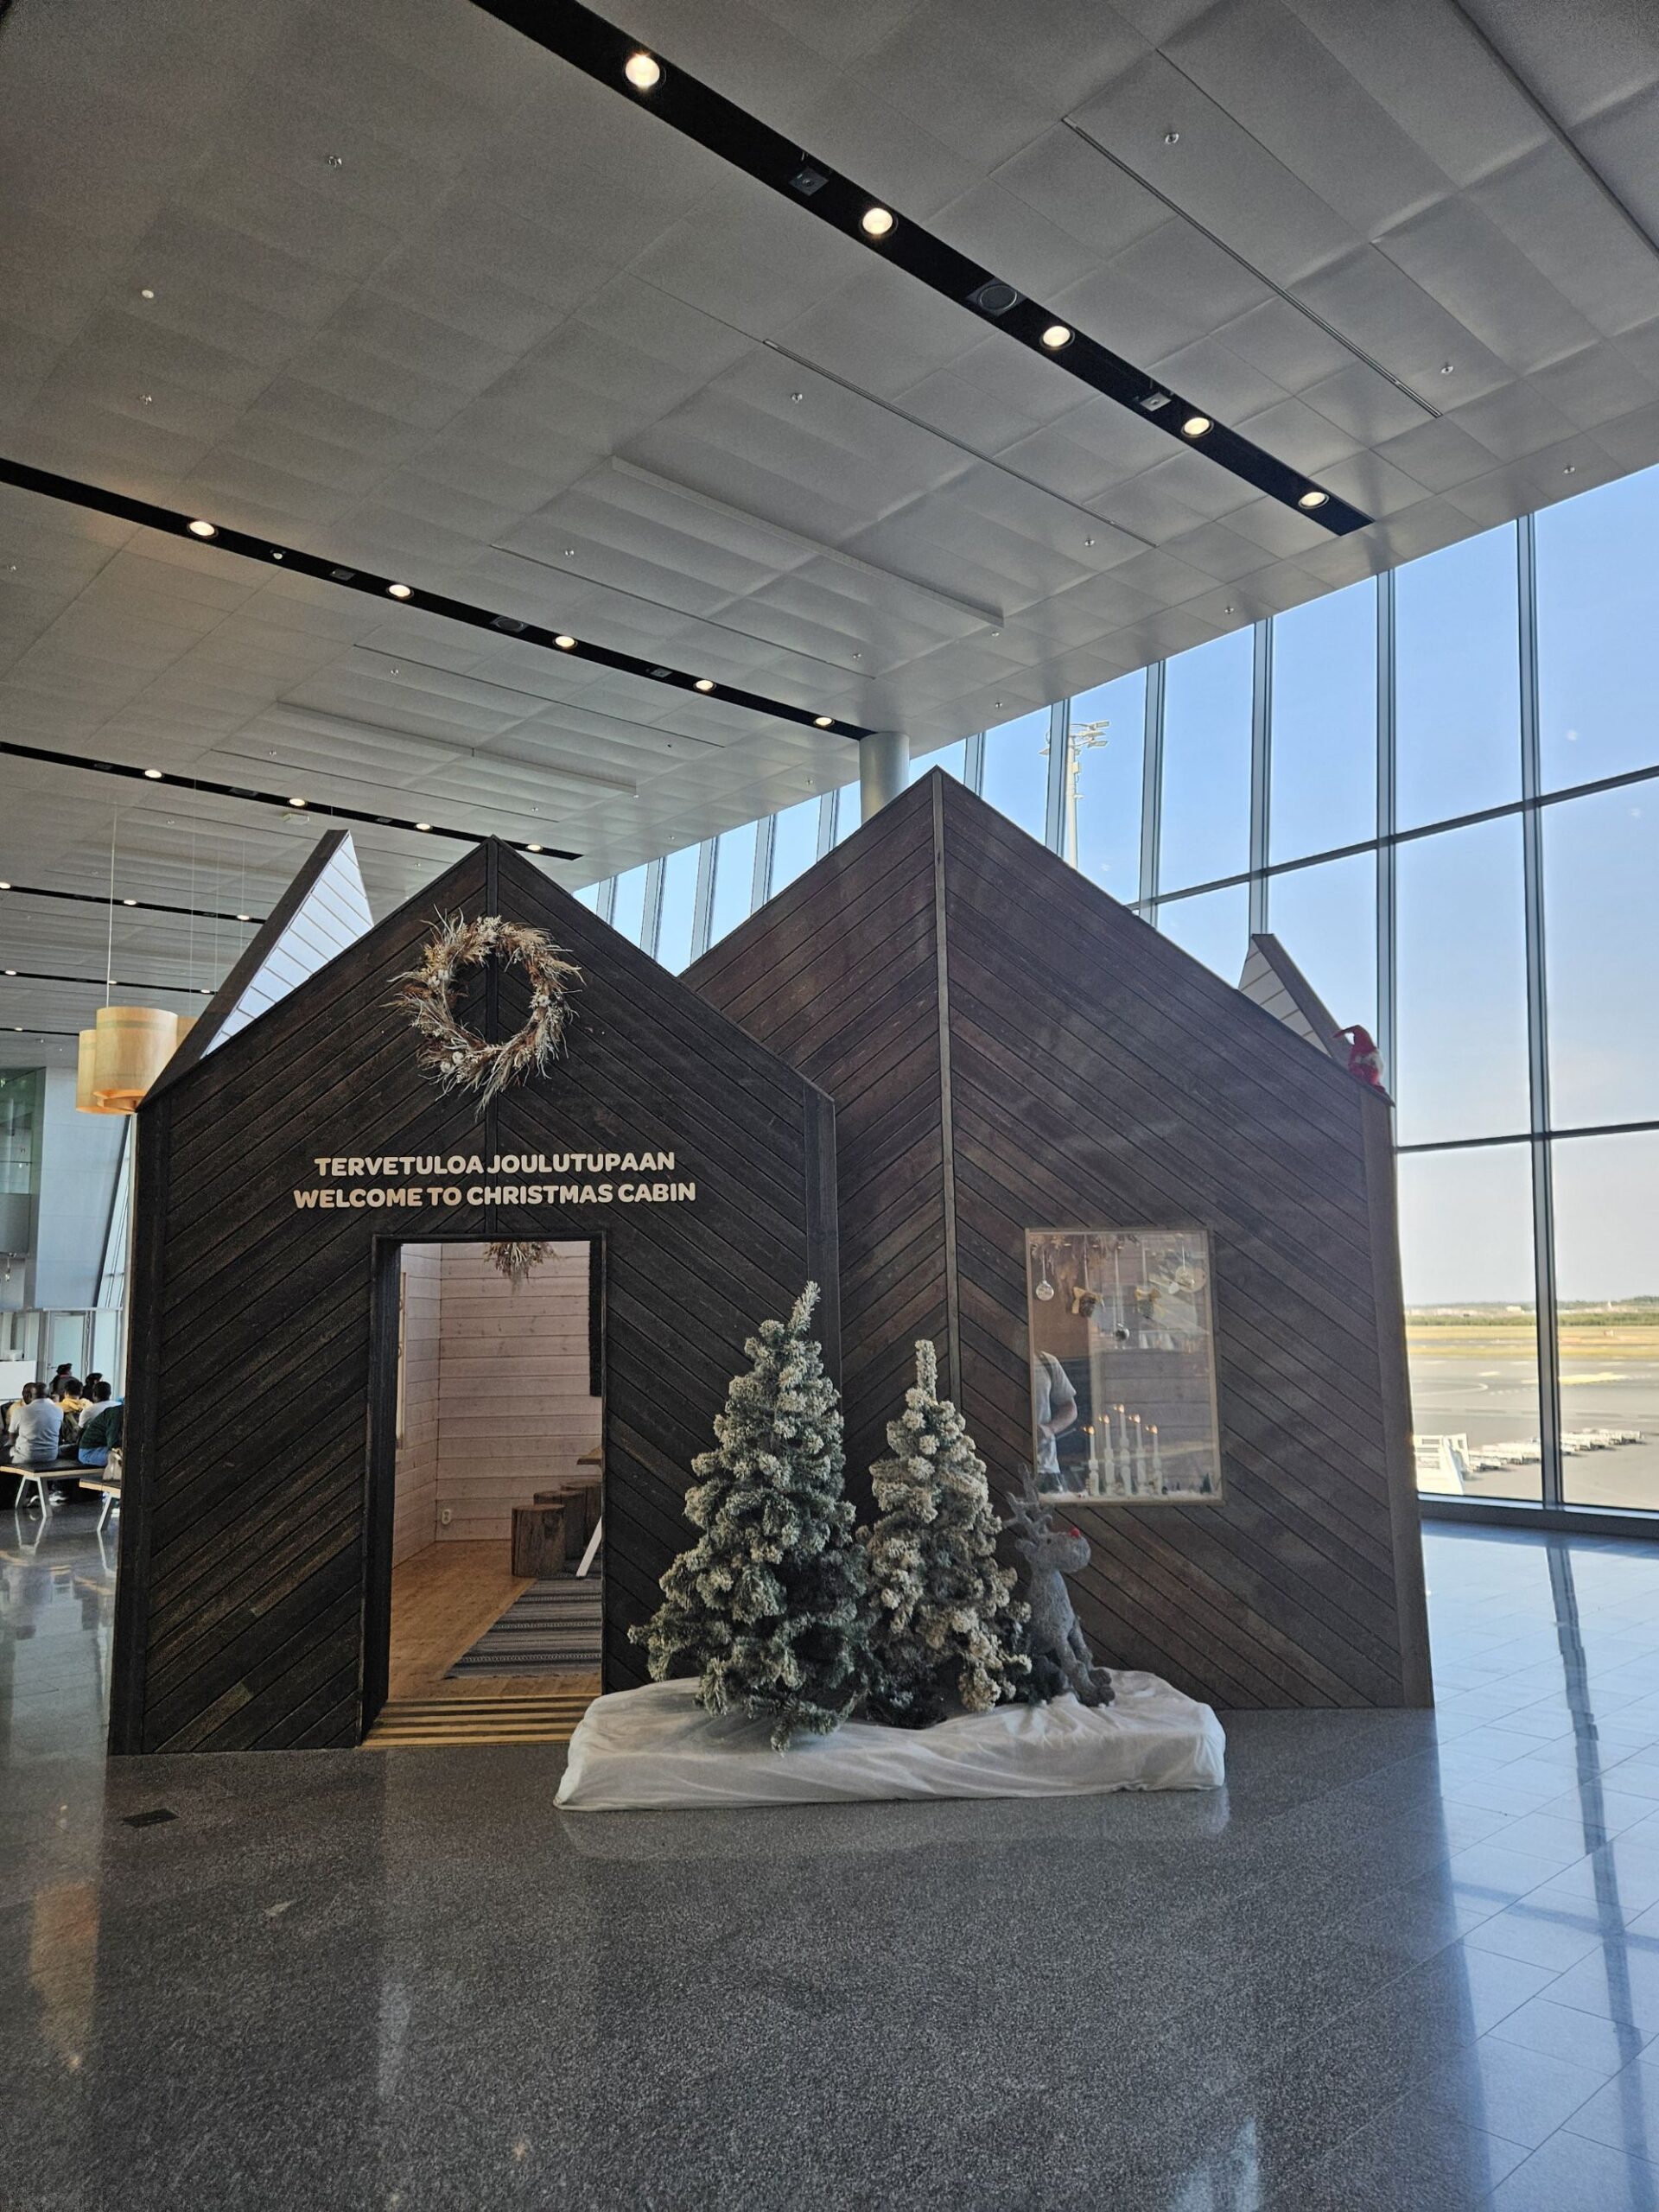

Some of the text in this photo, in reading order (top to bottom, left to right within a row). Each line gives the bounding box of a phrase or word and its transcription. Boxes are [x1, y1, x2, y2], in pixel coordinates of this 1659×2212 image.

[314, 1151, 676, 1177] TERVETULOA JOULUTUPAAN
[293, 1182, 696, 1209] WELCOME TO CHRISTMAS CABIN
